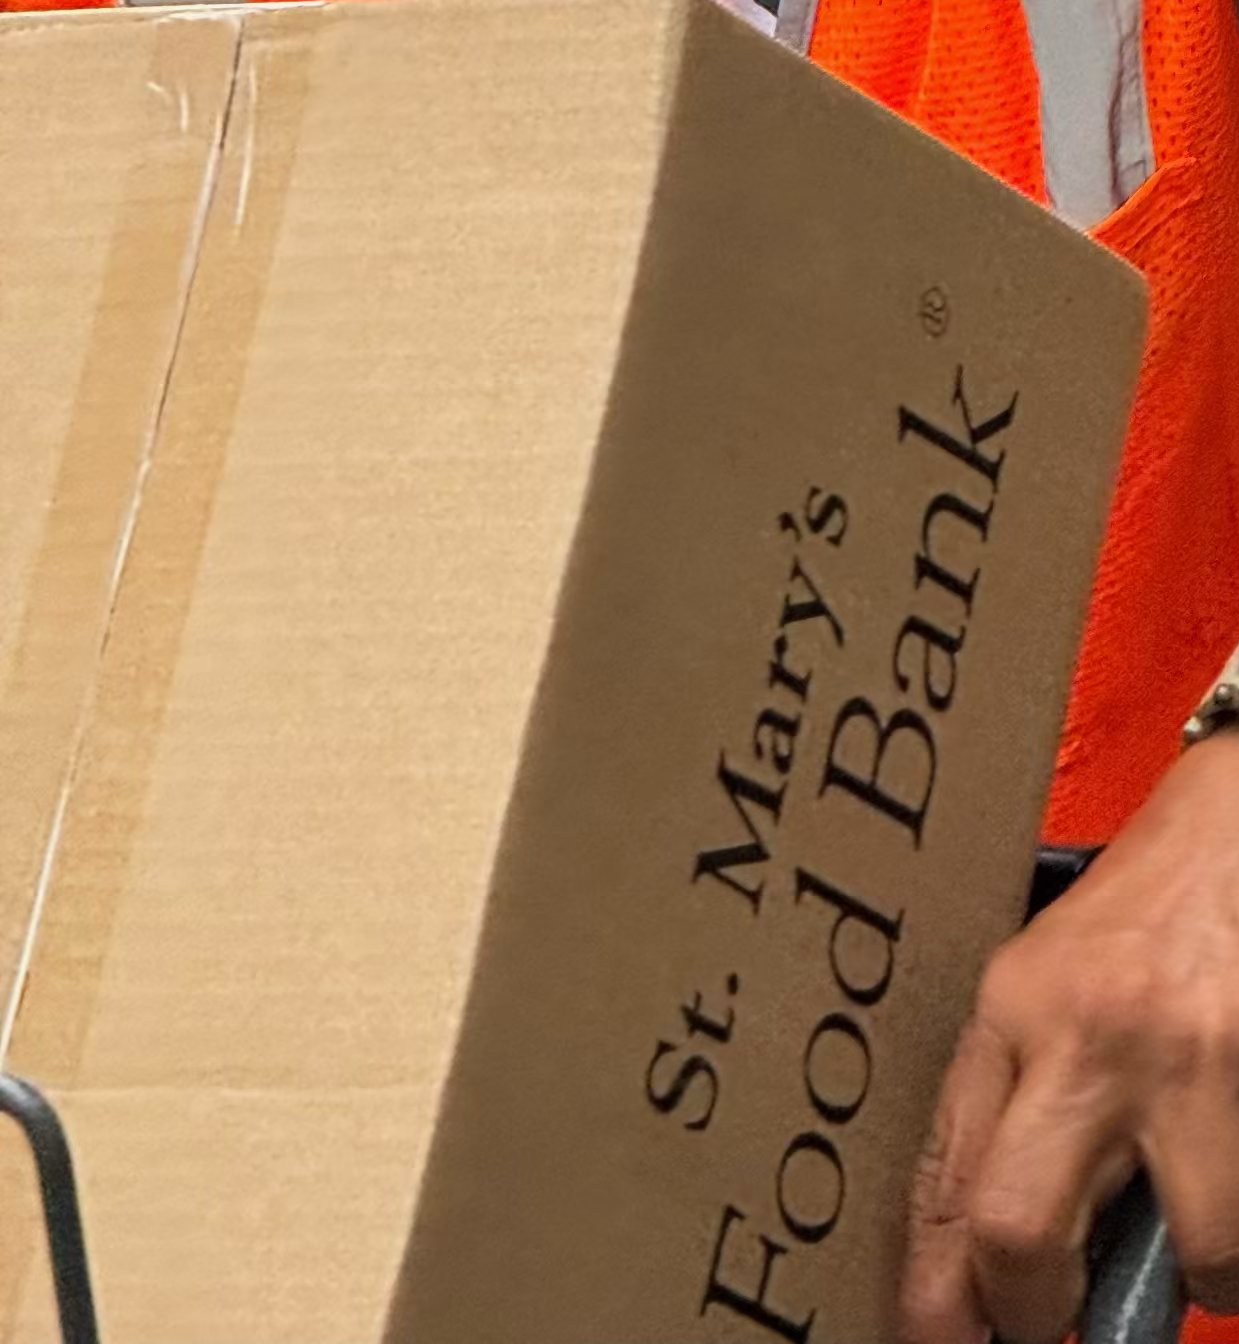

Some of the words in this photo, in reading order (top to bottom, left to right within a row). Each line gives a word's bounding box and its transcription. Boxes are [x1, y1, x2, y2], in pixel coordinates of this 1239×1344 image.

[692, 485, 850, 915] Mary's
[699, 867, 904, 1344] Food
[817, 364, 1020, 850] Bank
[646, 972, 740, 1132] St.
